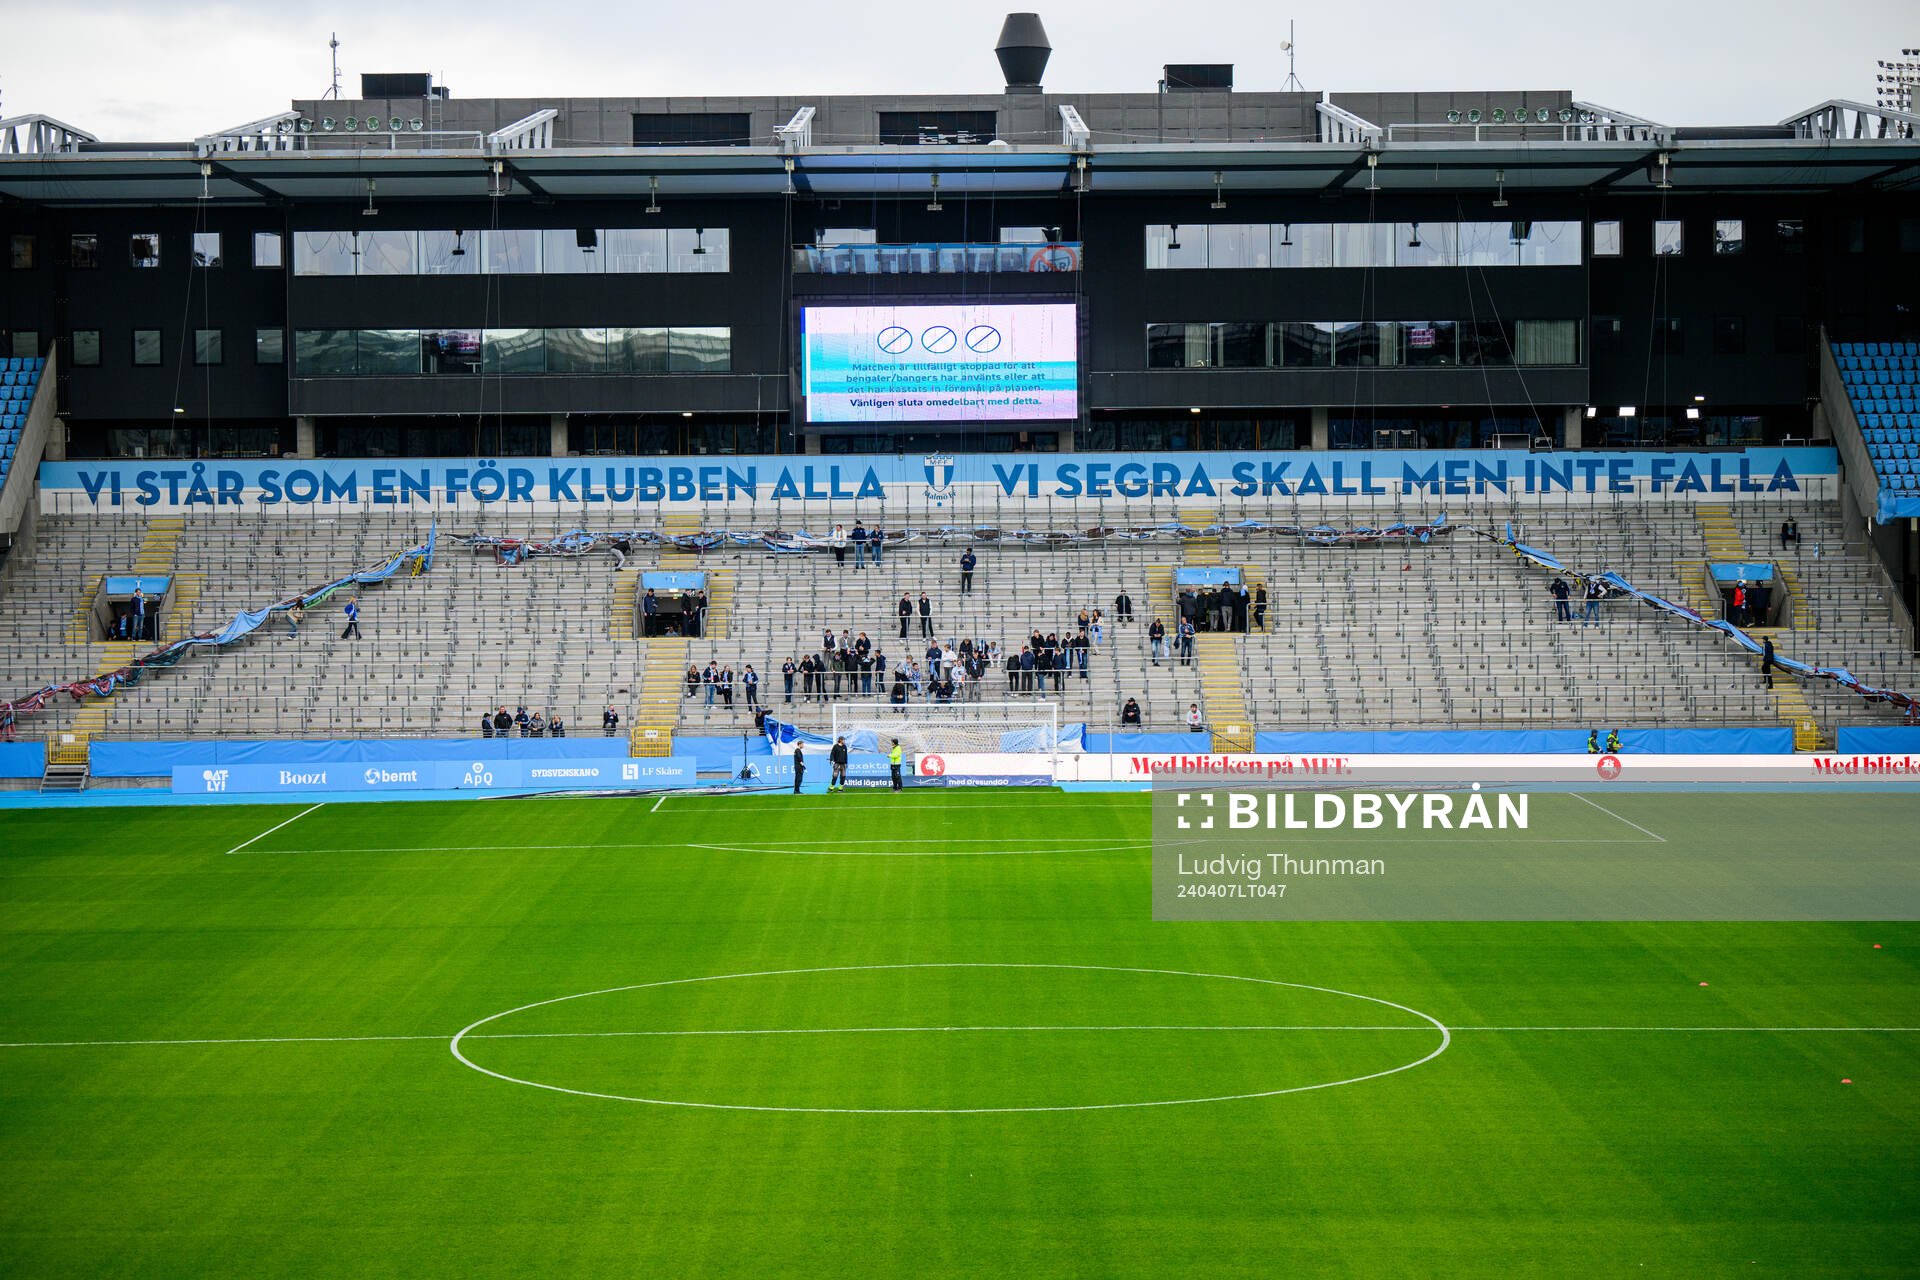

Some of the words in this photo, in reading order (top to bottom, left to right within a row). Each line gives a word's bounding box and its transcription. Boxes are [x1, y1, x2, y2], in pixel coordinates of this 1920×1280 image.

[852, 363, 896, 371] Matchen
[899, 362, 910, 371] är
[913, 361, 957, 372] tillfälligt
[960, 361, 1000, 371] stoppad
[1021, 361, 1036, 369] att
[941, 373, 958, 381] har
[961, 373, 1001, 381] använts
[1031, 372, 1045, 380] att
[868, 386, 886, 394] har
[889, 385, 928, 393] kastats
[850, 399, 895, 408] Vänligen
[898, 398, 923, 407] sluta
[926, 398, 984, 406] omedelbart
[1013, 397, 1042, 405] detta.
[77, 471, 120, 506] VI
[134, 462, 244, 506] STÅR
[257, 469, 358, 505] SOM
[372, 469, 430, 504] EN
[446, 459, 535, 504] FÖR
[550, 466, 756, 502] KLUBBEN
[771, 465, 886, 500] ALLA
[992, 463, 1038, 498] VI
[1055, 462, 1216, 498] SEGRA
[1230, 461, 1386, 497] SKALL
[1403, 460, 1507, 495] MEN
[1525, 459, 1634, 494] INTE
[1651, 457, 1800, 492] FALLA
[642, 767, 655, 776] LF
[655, 766, 683, 776] Skåne
[1129, 755, 1176, 775] Med
[1181, 754, 1263, 775] blicken
[1267, 753, 1294, 778] på
[1299, 756, 1353, 775] MFF.
[1812, 757, 1860, 775] Med
[1863, 755, 1920, 775] blick
[279, 770, 327, 785] Boozt
[381, 769, 417, 783] bemt
[464, 772, 493, 786] ApQ
[531, 768, 592, 777] SYDSVENSKAN
